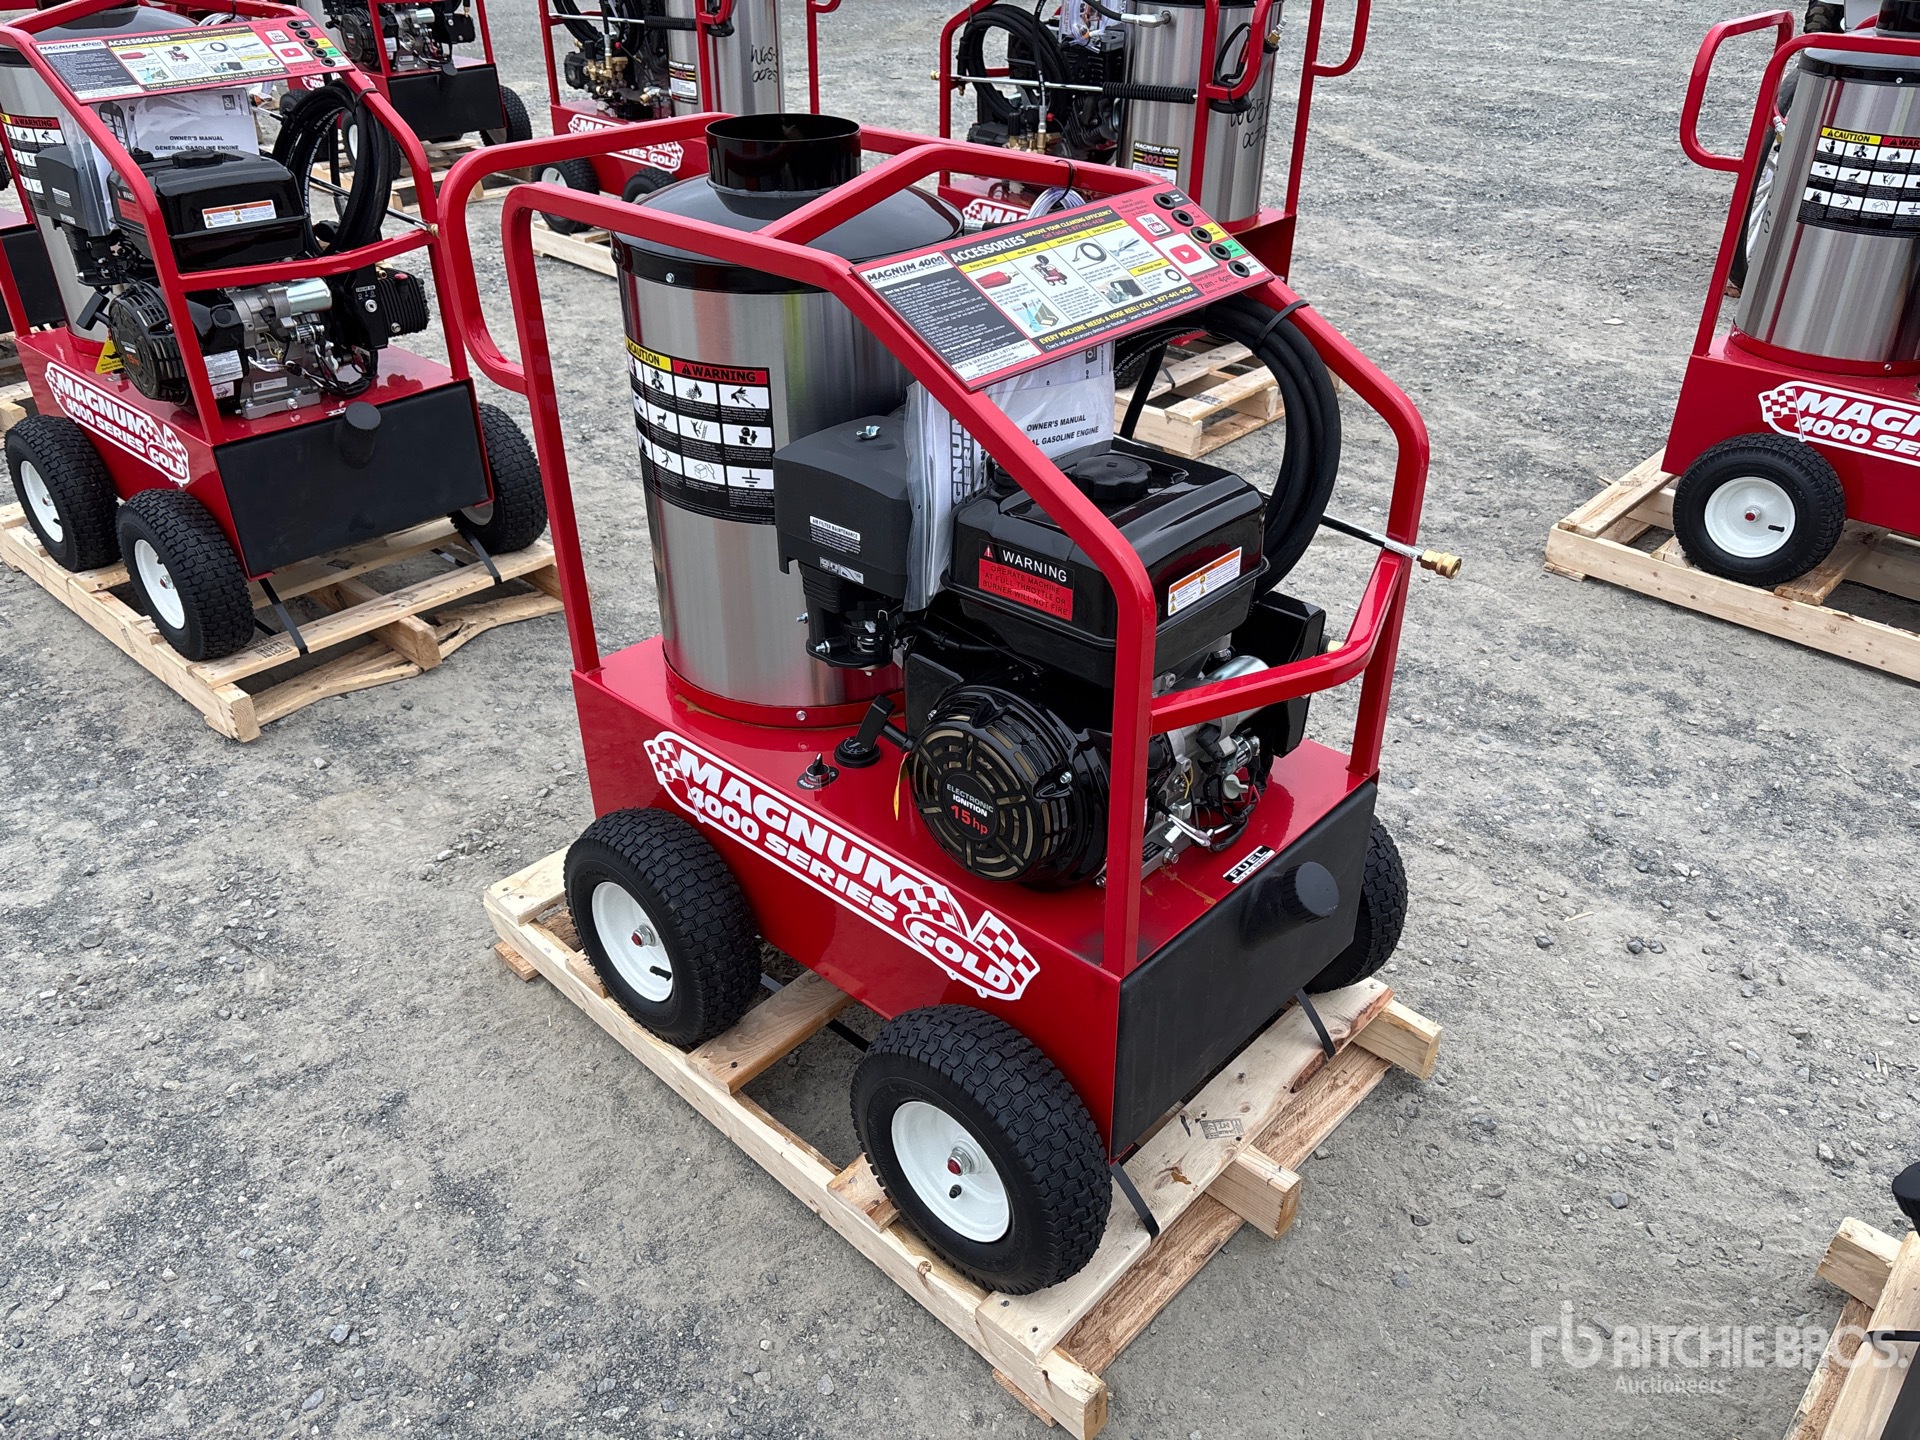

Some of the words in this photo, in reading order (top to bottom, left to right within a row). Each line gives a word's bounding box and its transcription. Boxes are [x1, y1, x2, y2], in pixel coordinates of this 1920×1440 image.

[39, 43, 80, 51] MAGNUM
[106, 35, 171, 46] ACCESSORIES
[19, 118, 52, 127] WARNING
[1833, 130, 1870, 143] CAUTION
[650, 153, 677, 167] GOLD
[1134, 142, 1161, 153] MAGNUM
[1161, 147, 1179, 155] 4000
[1143, 153, 1165, 166] 2025
[1141, 215, 1155, 223] You
[1148, 222, 1165, 232] Tube
[947, 234, 1028, 263] ACCESSORIES
[1059, 217, 1087, 227] CLEANING
[1083, 209, 1114, 220] EFFICIENCY
[863, 261, 919, 282] MAGNUM
[914, 254, 946, 268] 4000
[1197, 280, 1216, 289] 7am
[1216, 273, 1235, 283] 4pm
[1037, 333, 1061, 344] EVERY
[1057, 323, 1087, 337] MACHINE
[1084, 317, 1106, 328] NEEDS
[1107, 310, 1126, 319] HOSE
[1122, 304, 1141, 314] REEL!
[1137, 300, 1154, 308] CALL
[1151, 285, 1194, 303] 1-877-441-4430
[1072, 331, 1094, 341] accessory
[631, 343, 660, 366] CAUTION
[692, 367, 756, 382] WARNING
[56, 373, 146, 437] MAGNUM
[66, 397, 95, 424] 4000
[96, 417, 145, 454] SERIES
[1026, 419, 1059, 432] OWNER'S
[1060, 414, 1086, 427] MANUAL
[1794, 416, 1872, 445] 4000
[1041, 432, 1075, 446] GASOLINE
[1076, 425, 1099, 438] ENGINE
[150, 448, 185, 476] GOLD
[819, 520, 831, 530] FILTER
[832, 525, 858, 540] MAINTENANCE
[1003, 549, 1067, 582] WARNING
[991, 565, 1025, 582] OPERATE
[1028, 576, 1060, 595] MACHINE
[996, 575, 1013, 587] FULL
[1017, 581, 1054, 601] THROTTLE
[982, 580, 1012, 594] BURNER
[1014, 590, 1032, 602] WILL
[1033, 598, 1049, 607] NOT
[1051, 603, 1067, 616] FIRE
[946, 783, 994, 813] ELECTRONIC
[952, 794, 988, 817] IGNITION
[679, 747, 912, 908] MAGNUM
[687, 785, 759, 842] 4000
[764, 831, 899, 923] SERIES
[1230, 851, 1267, 878] FUEL
[909, 921, 1010, 992] GOLD
